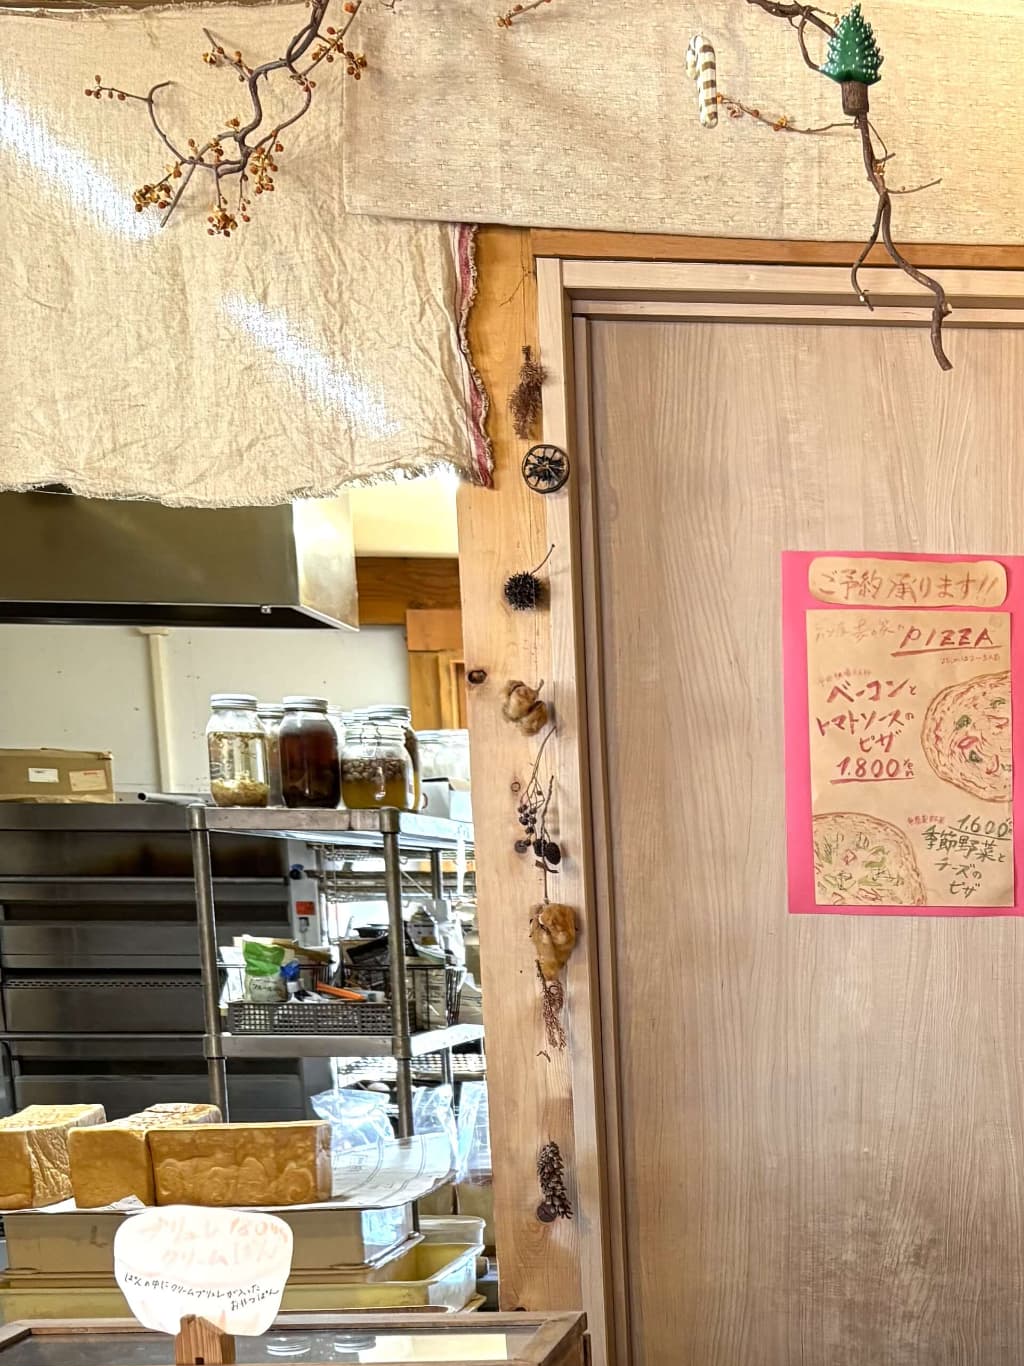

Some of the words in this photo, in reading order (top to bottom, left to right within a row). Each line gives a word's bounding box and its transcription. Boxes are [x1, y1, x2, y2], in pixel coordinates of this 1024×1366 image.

[900, 625, 993, 649] PIZZA
[827, 678, 917, 703] ベーコンと
[816, 709, 915, 737] トマトソースの
[859, 729, 902, 753] ピザ
[921, 825, 1006, 863] 季節野菜と
[934, 857, 982, 880] チーズの
[949, 880, 981, 899] ピザ
